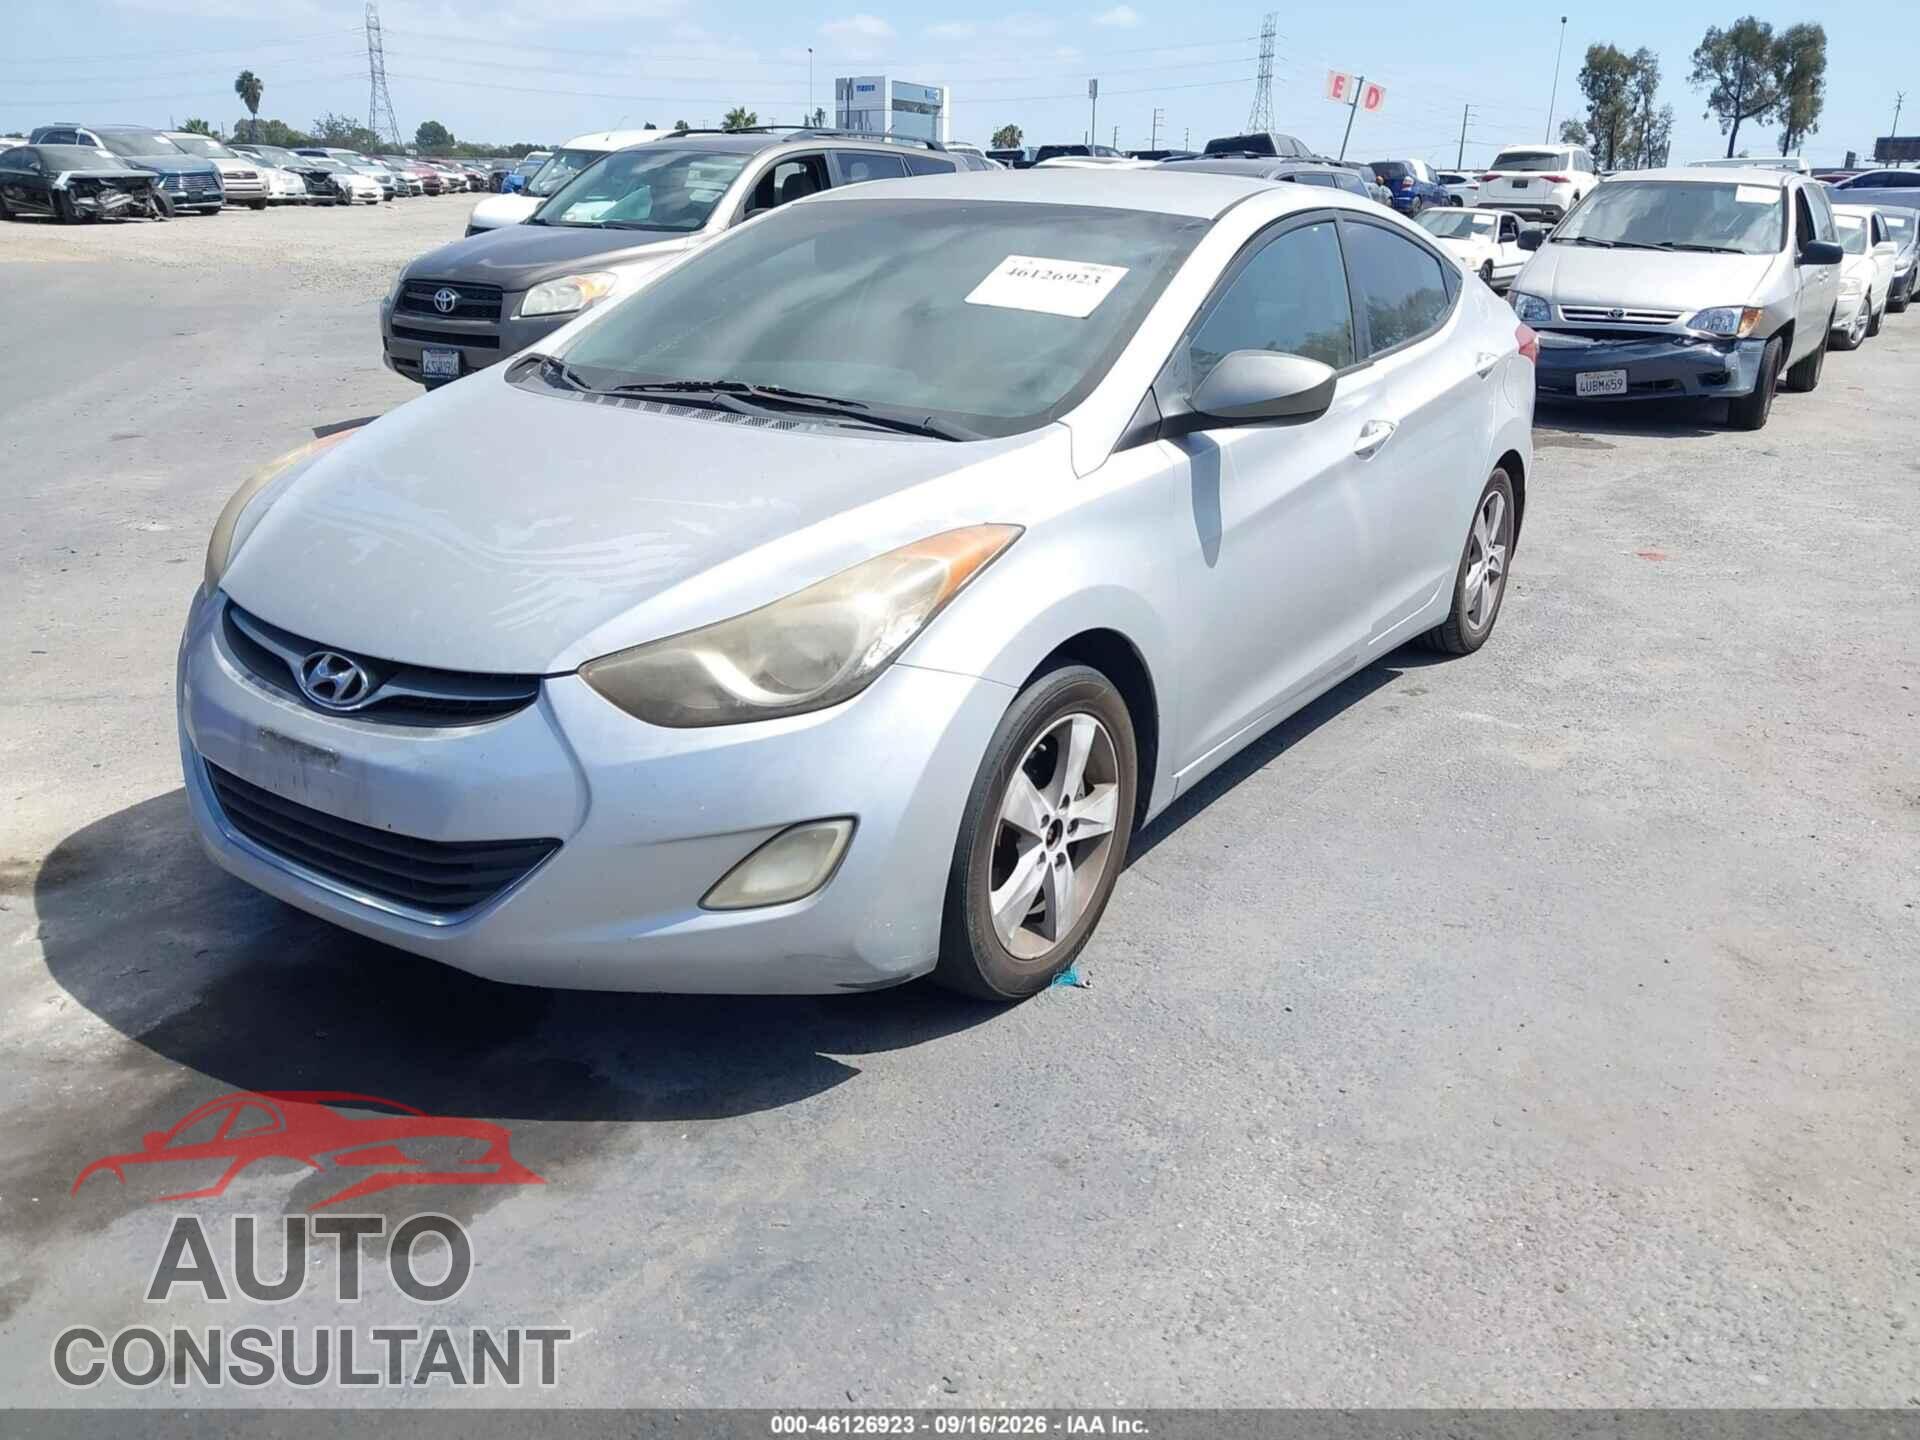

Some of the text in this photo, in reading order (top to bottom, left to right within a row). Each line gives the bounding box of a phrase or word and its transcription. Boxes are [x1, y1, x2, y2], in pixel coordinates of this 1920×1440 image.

[1333, 75, 1345, 98] E
[1365, 86, 1380, 109] D
[1580, 378, 1623, 392] 4UBM659
